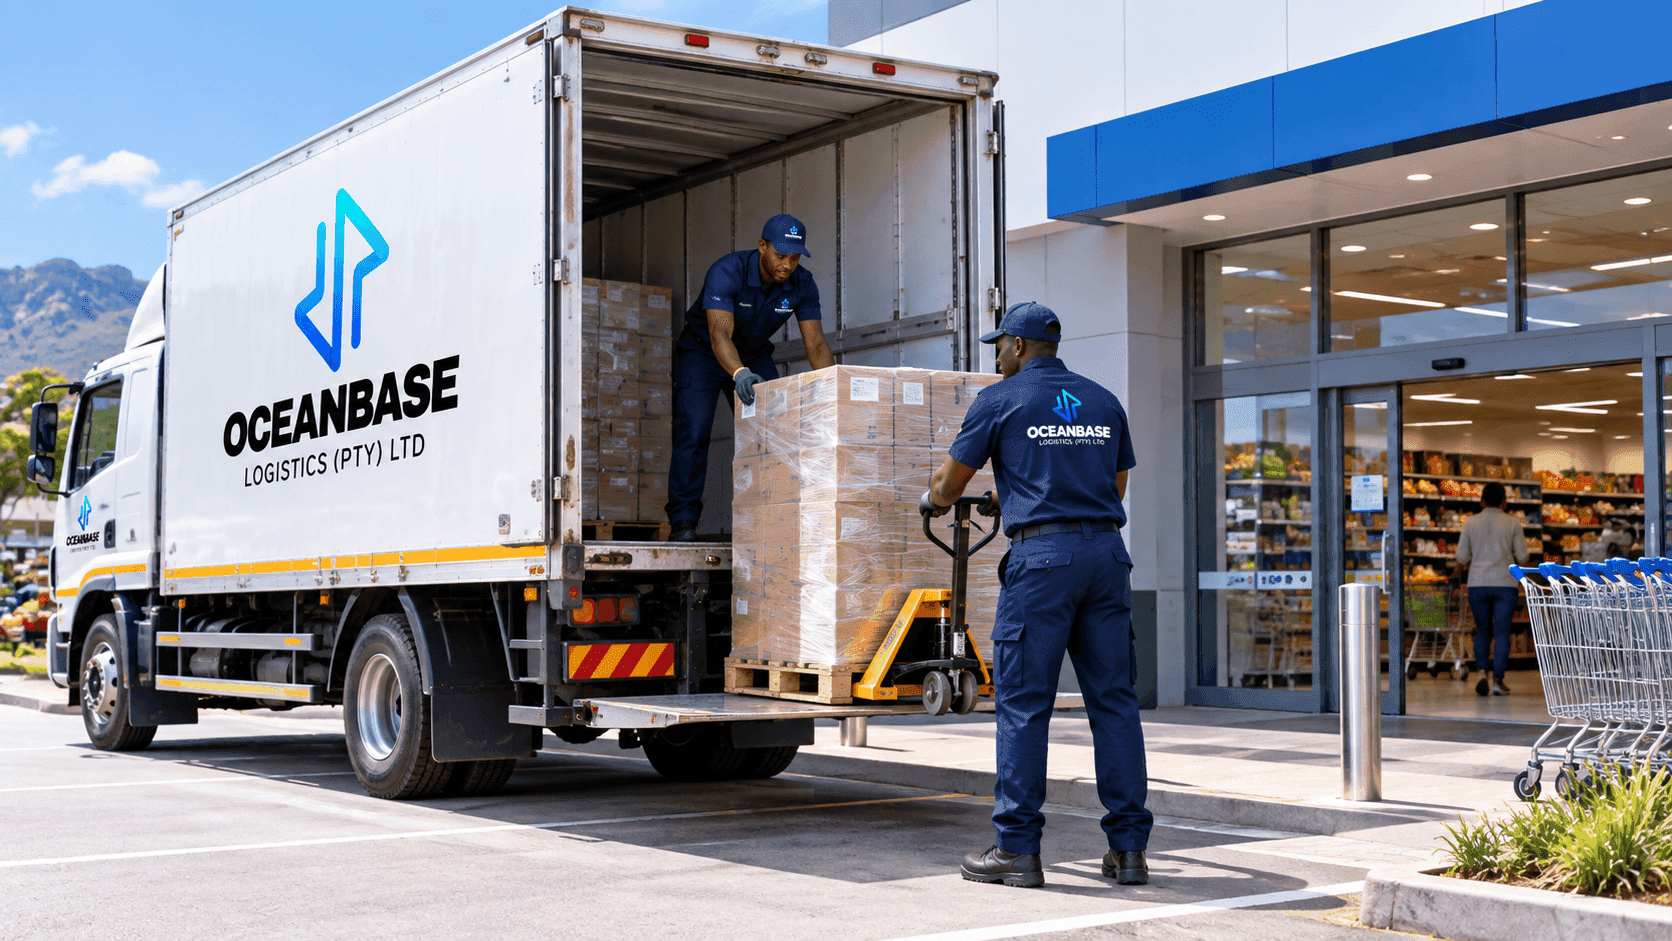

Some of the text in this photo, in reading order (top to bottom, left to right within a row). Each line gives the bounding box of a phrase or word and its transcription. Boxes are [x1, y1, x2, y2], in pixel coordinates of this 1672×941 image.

[223, 354, 460, 458] OCEANBASE
[1027, 425, 1111, 438] OCEANBASE
[244, 433, 425, 488] LOGISTICS (PTY) LTD
